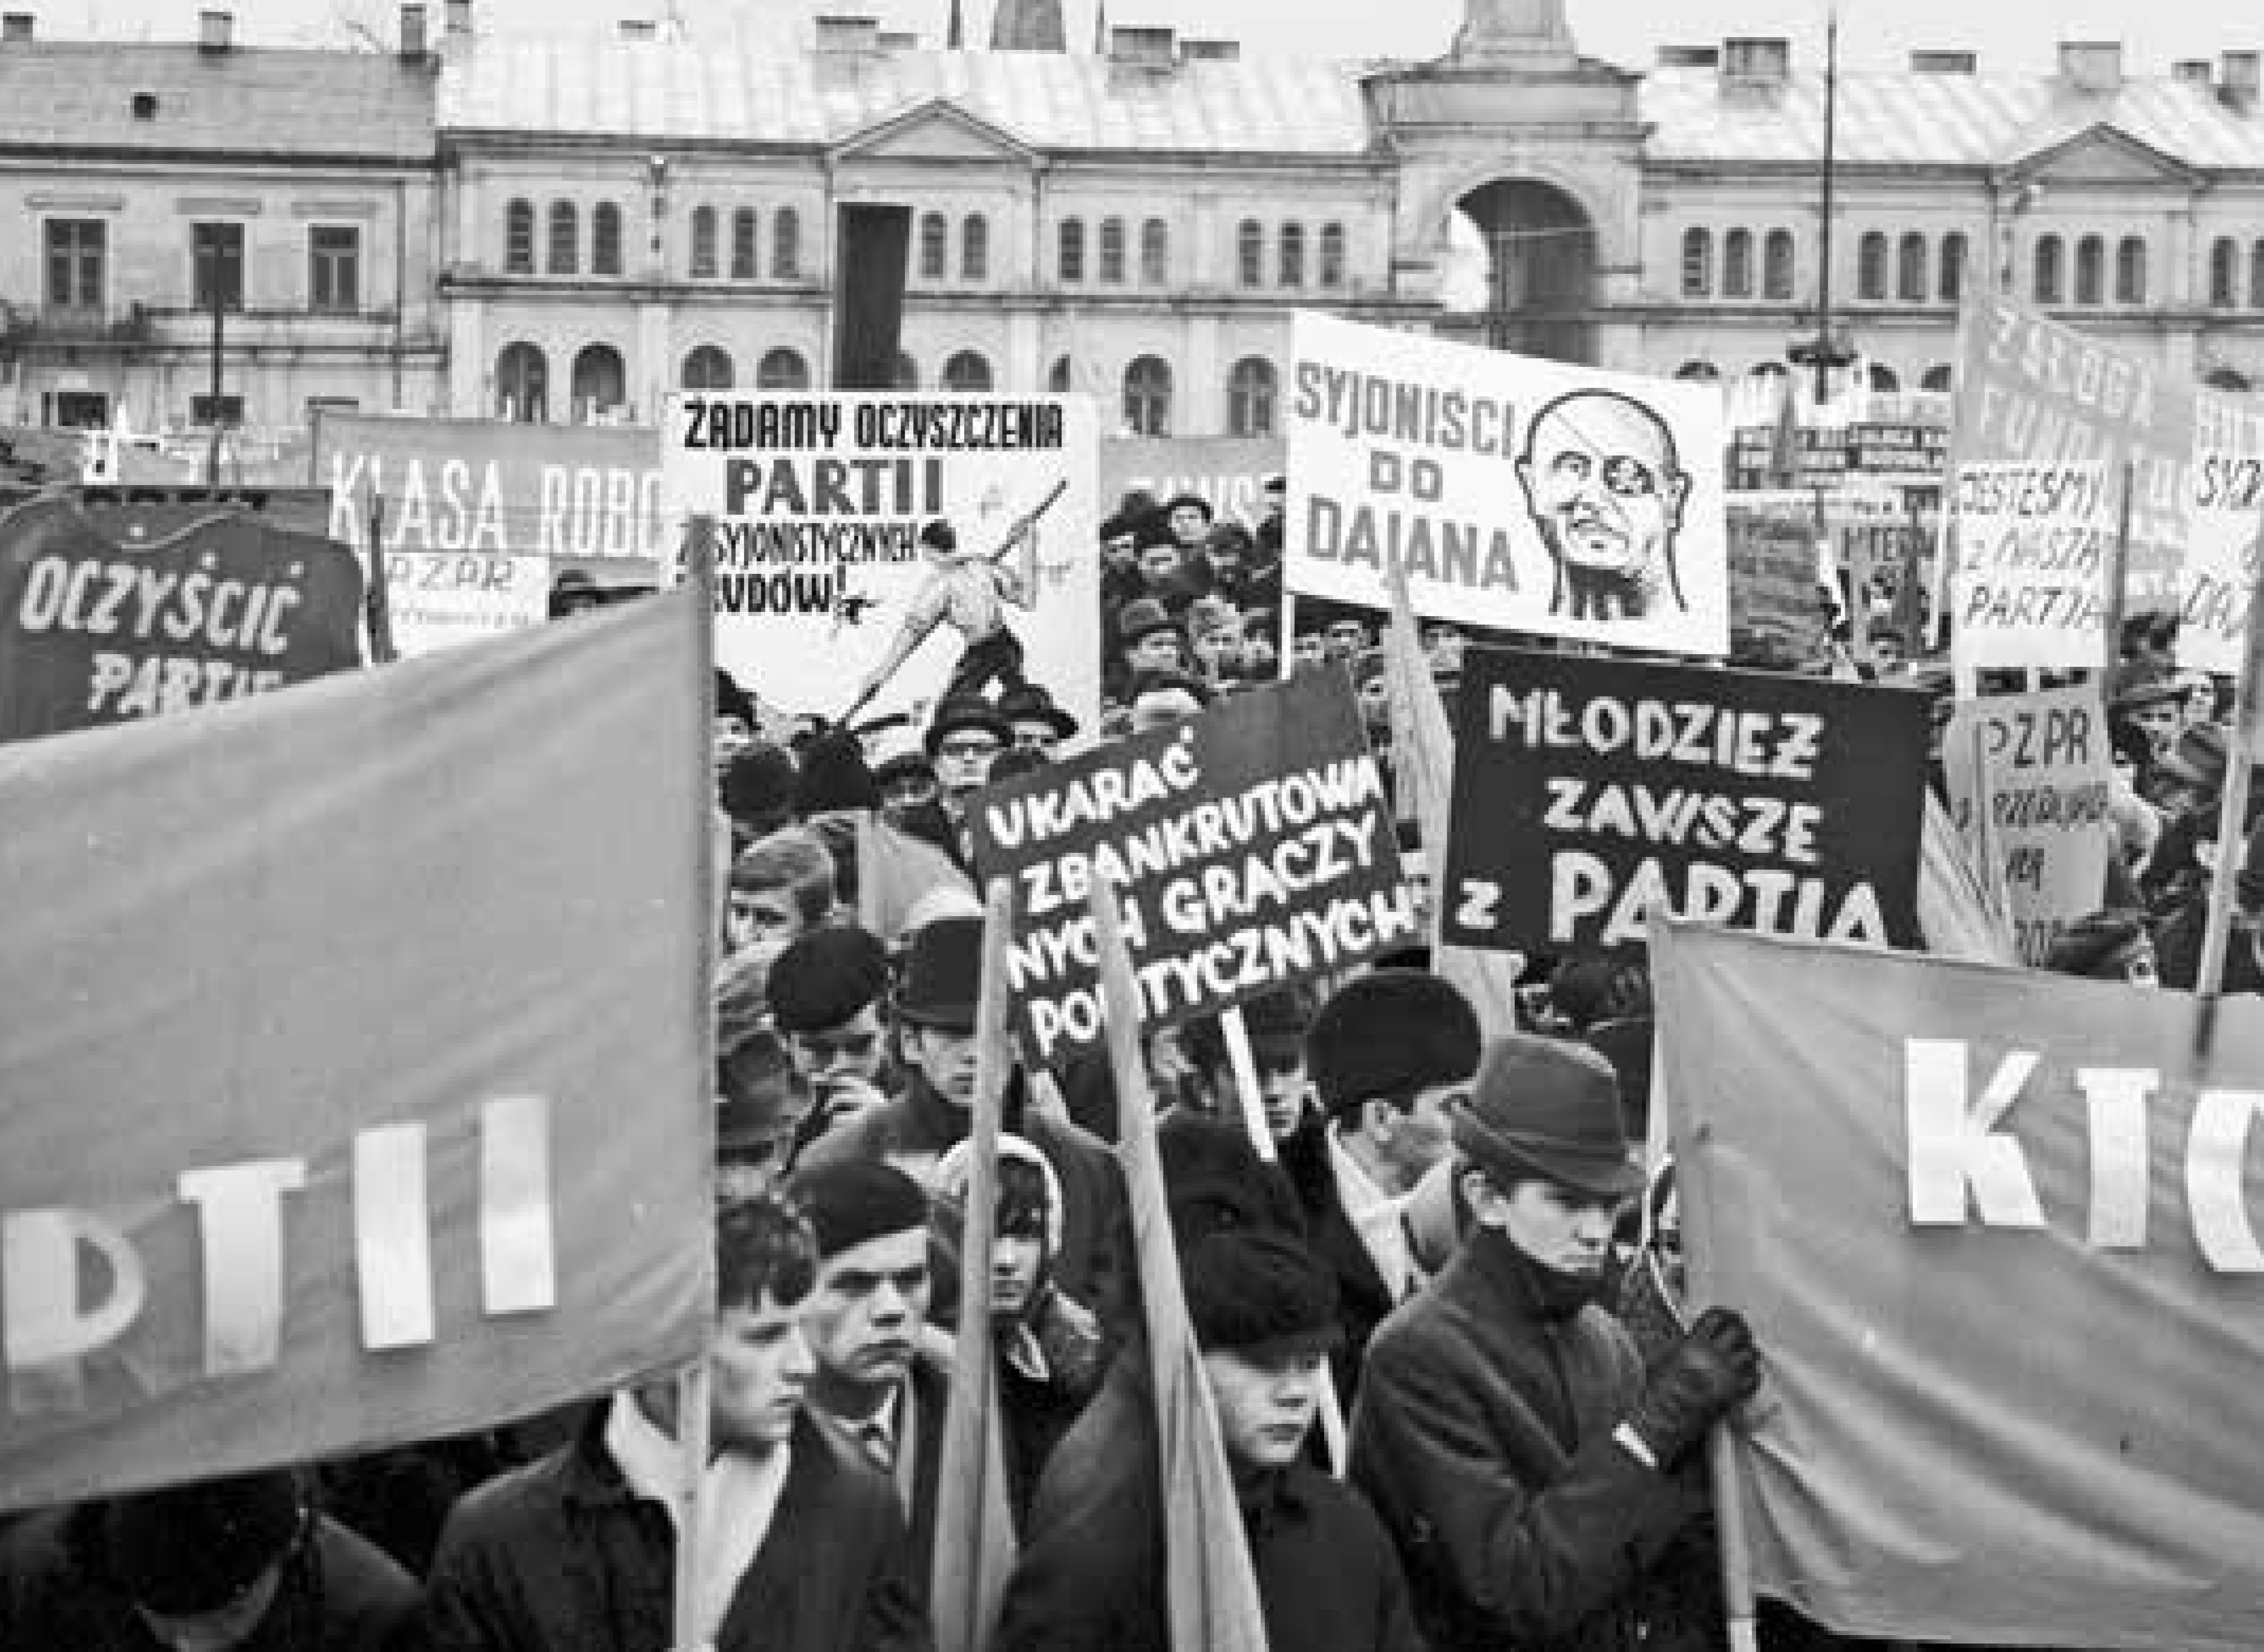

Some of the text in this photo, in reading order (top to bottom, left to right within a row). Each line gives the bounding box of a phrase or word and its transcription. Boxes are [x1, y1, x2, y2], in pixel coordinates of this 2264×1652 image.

[856, 402, 1063, 449] OCZYSZCZENIA
[725, 458, 944, 516] PARTII
[1370, 450, 1444, 502] DO
[19, 552, 303, 654] OCZYŚCIĆ
[985, 725, 1203, 849] UKARAĆ
[1544, 776, 1824, 864] ZAWSZE
[1163, 810, 1377, 933] GRACZY
